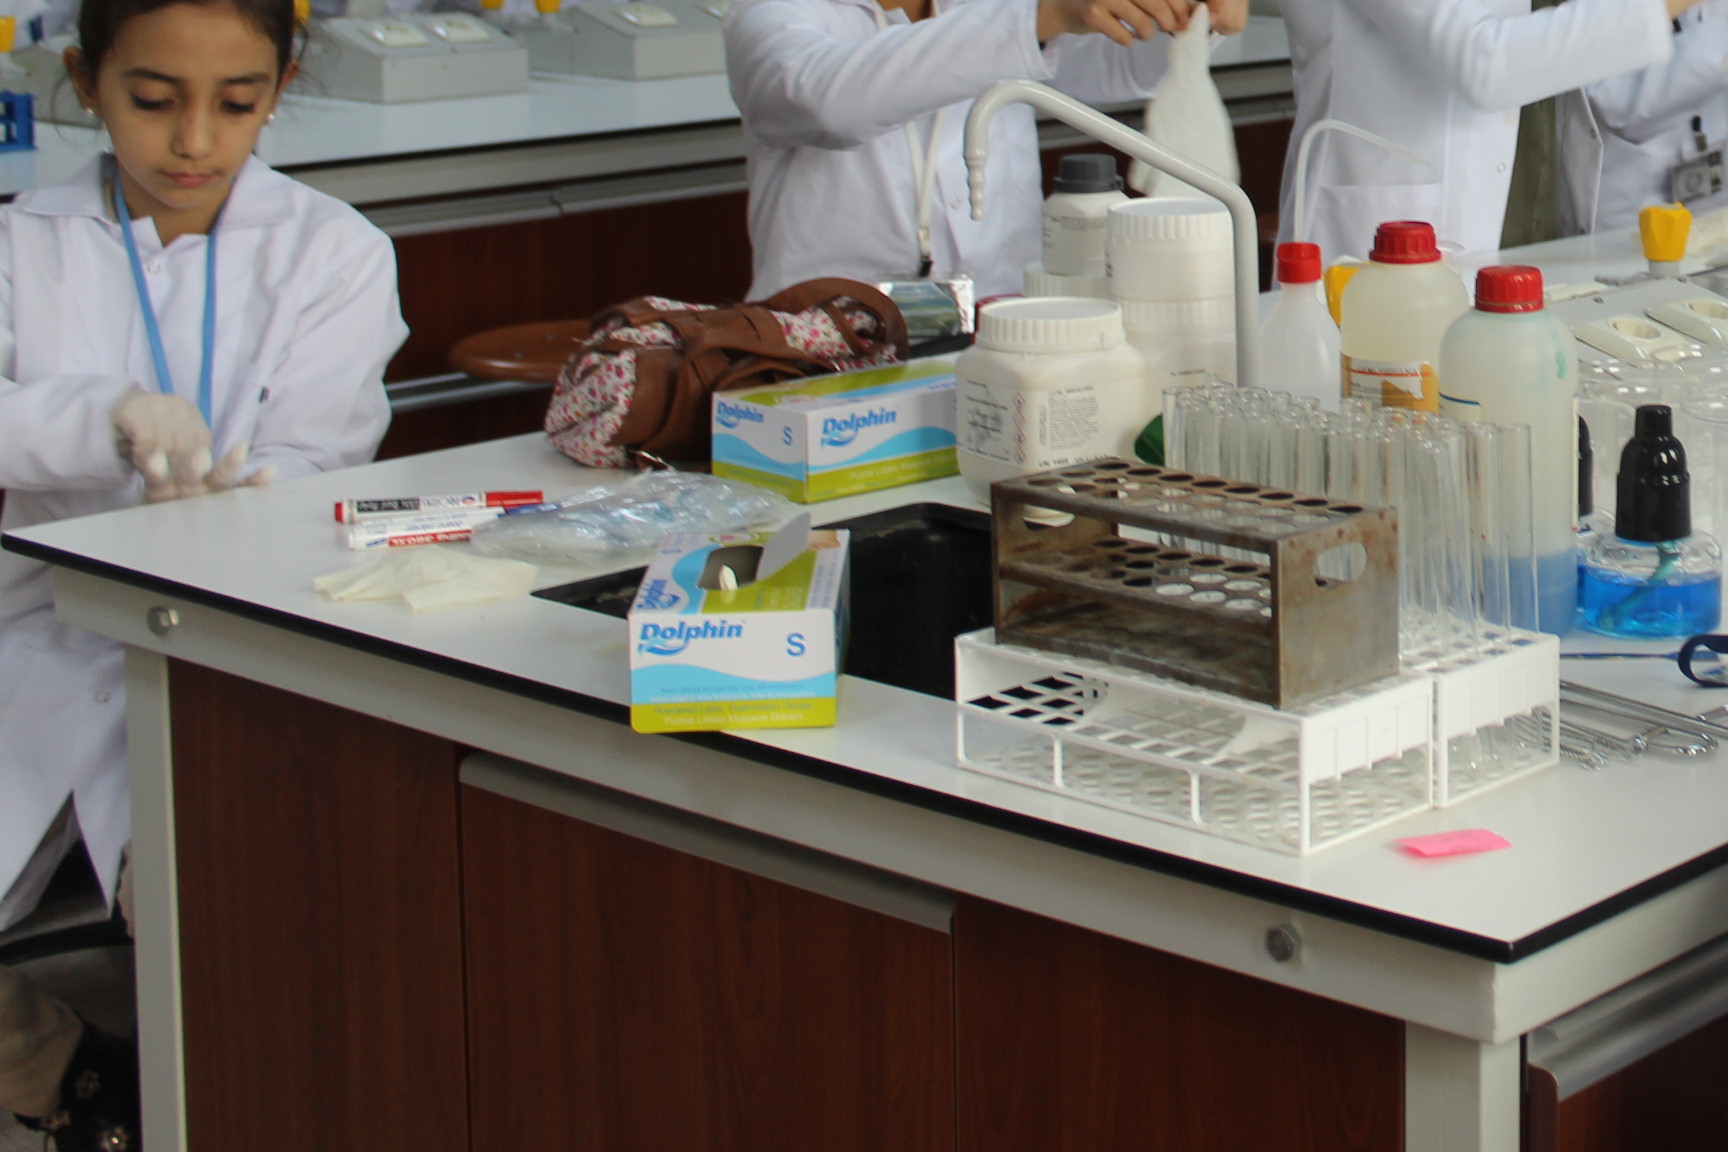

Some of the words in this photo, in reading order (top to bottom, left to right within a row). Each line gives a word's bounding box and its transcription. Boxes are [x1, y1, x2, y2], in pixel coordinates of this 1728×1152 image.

[716, 402, 764, 424] Dolphin
[822, 407, 897, 435] Dolphin
[782, 426, 793, 446] S
[639, 620, 744, 645] Dolphin
[786, 633, 806, 657] S
